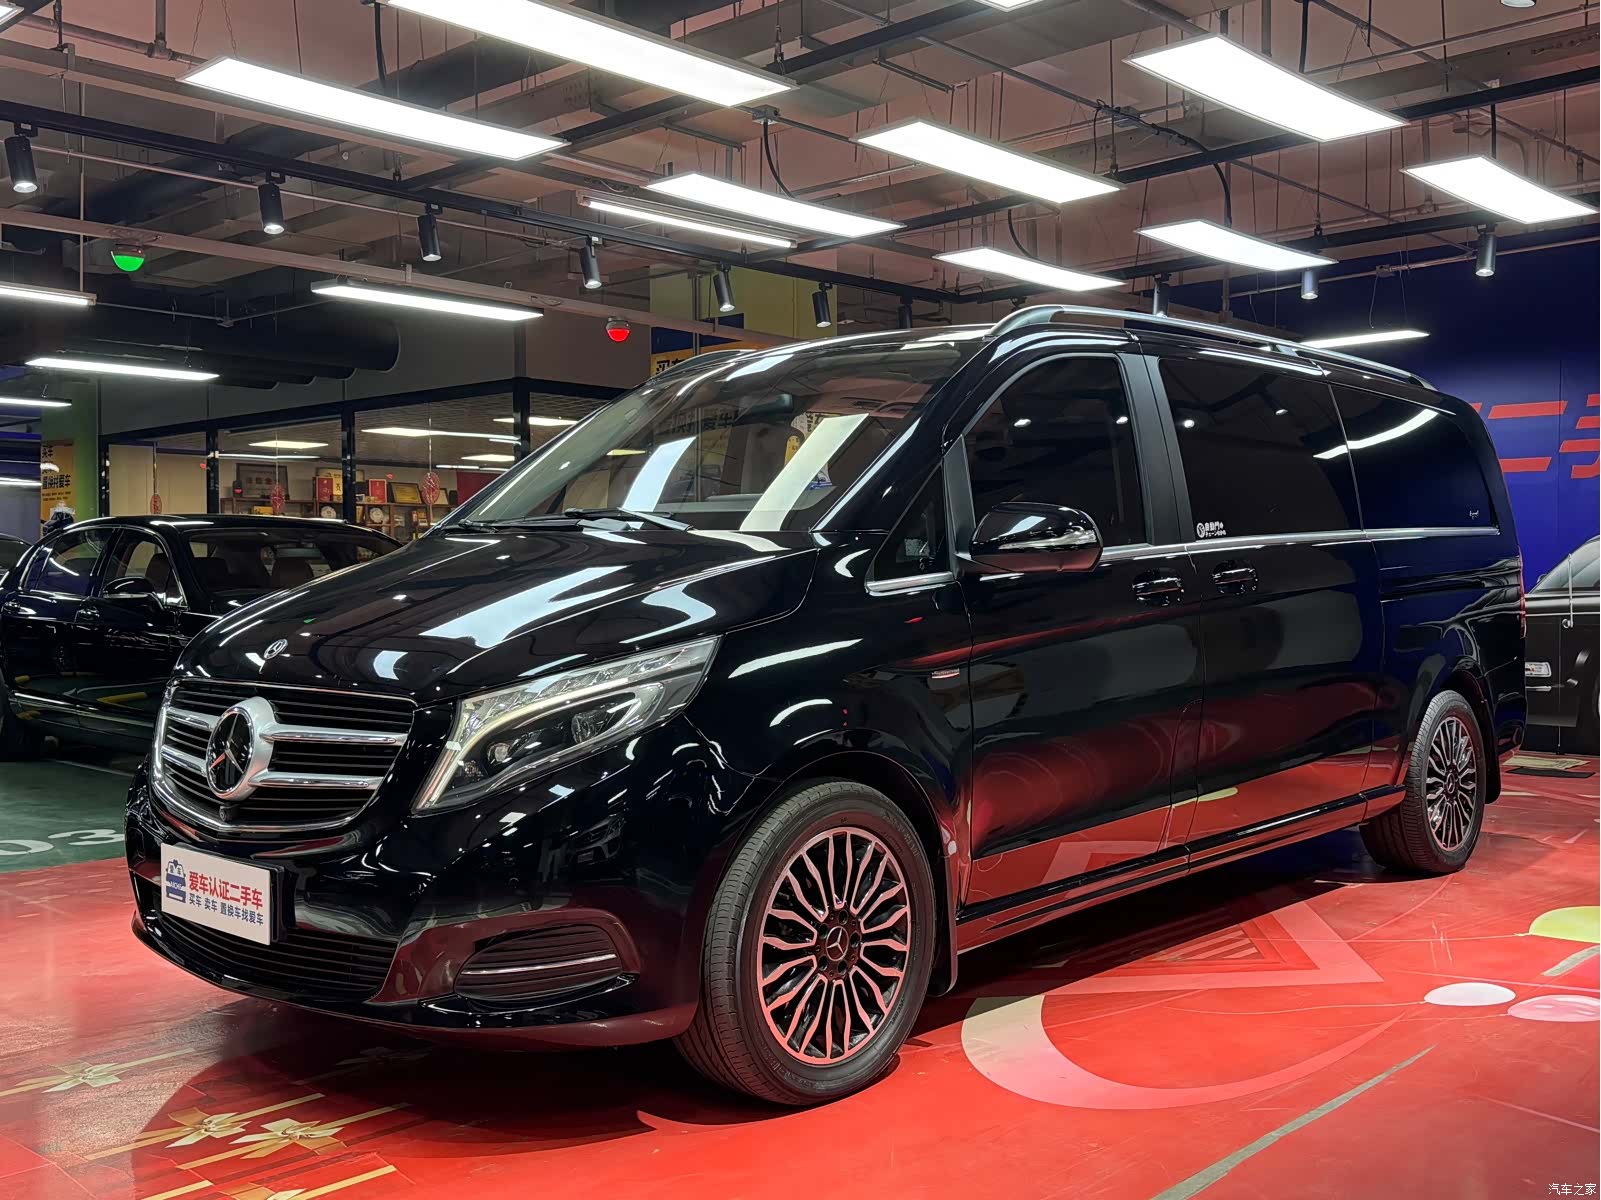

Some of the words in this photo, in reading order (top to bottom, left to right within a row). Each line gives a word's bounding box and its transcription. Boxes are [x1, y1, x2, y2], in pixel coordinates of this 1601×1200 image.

[189, 871, 263, 909] 爱车认证二手车
[189, 893, 202, 907] 买车
[204, 897, 218, 912] 卖车
[220, 901, 264, 926] 置换车找爱车
